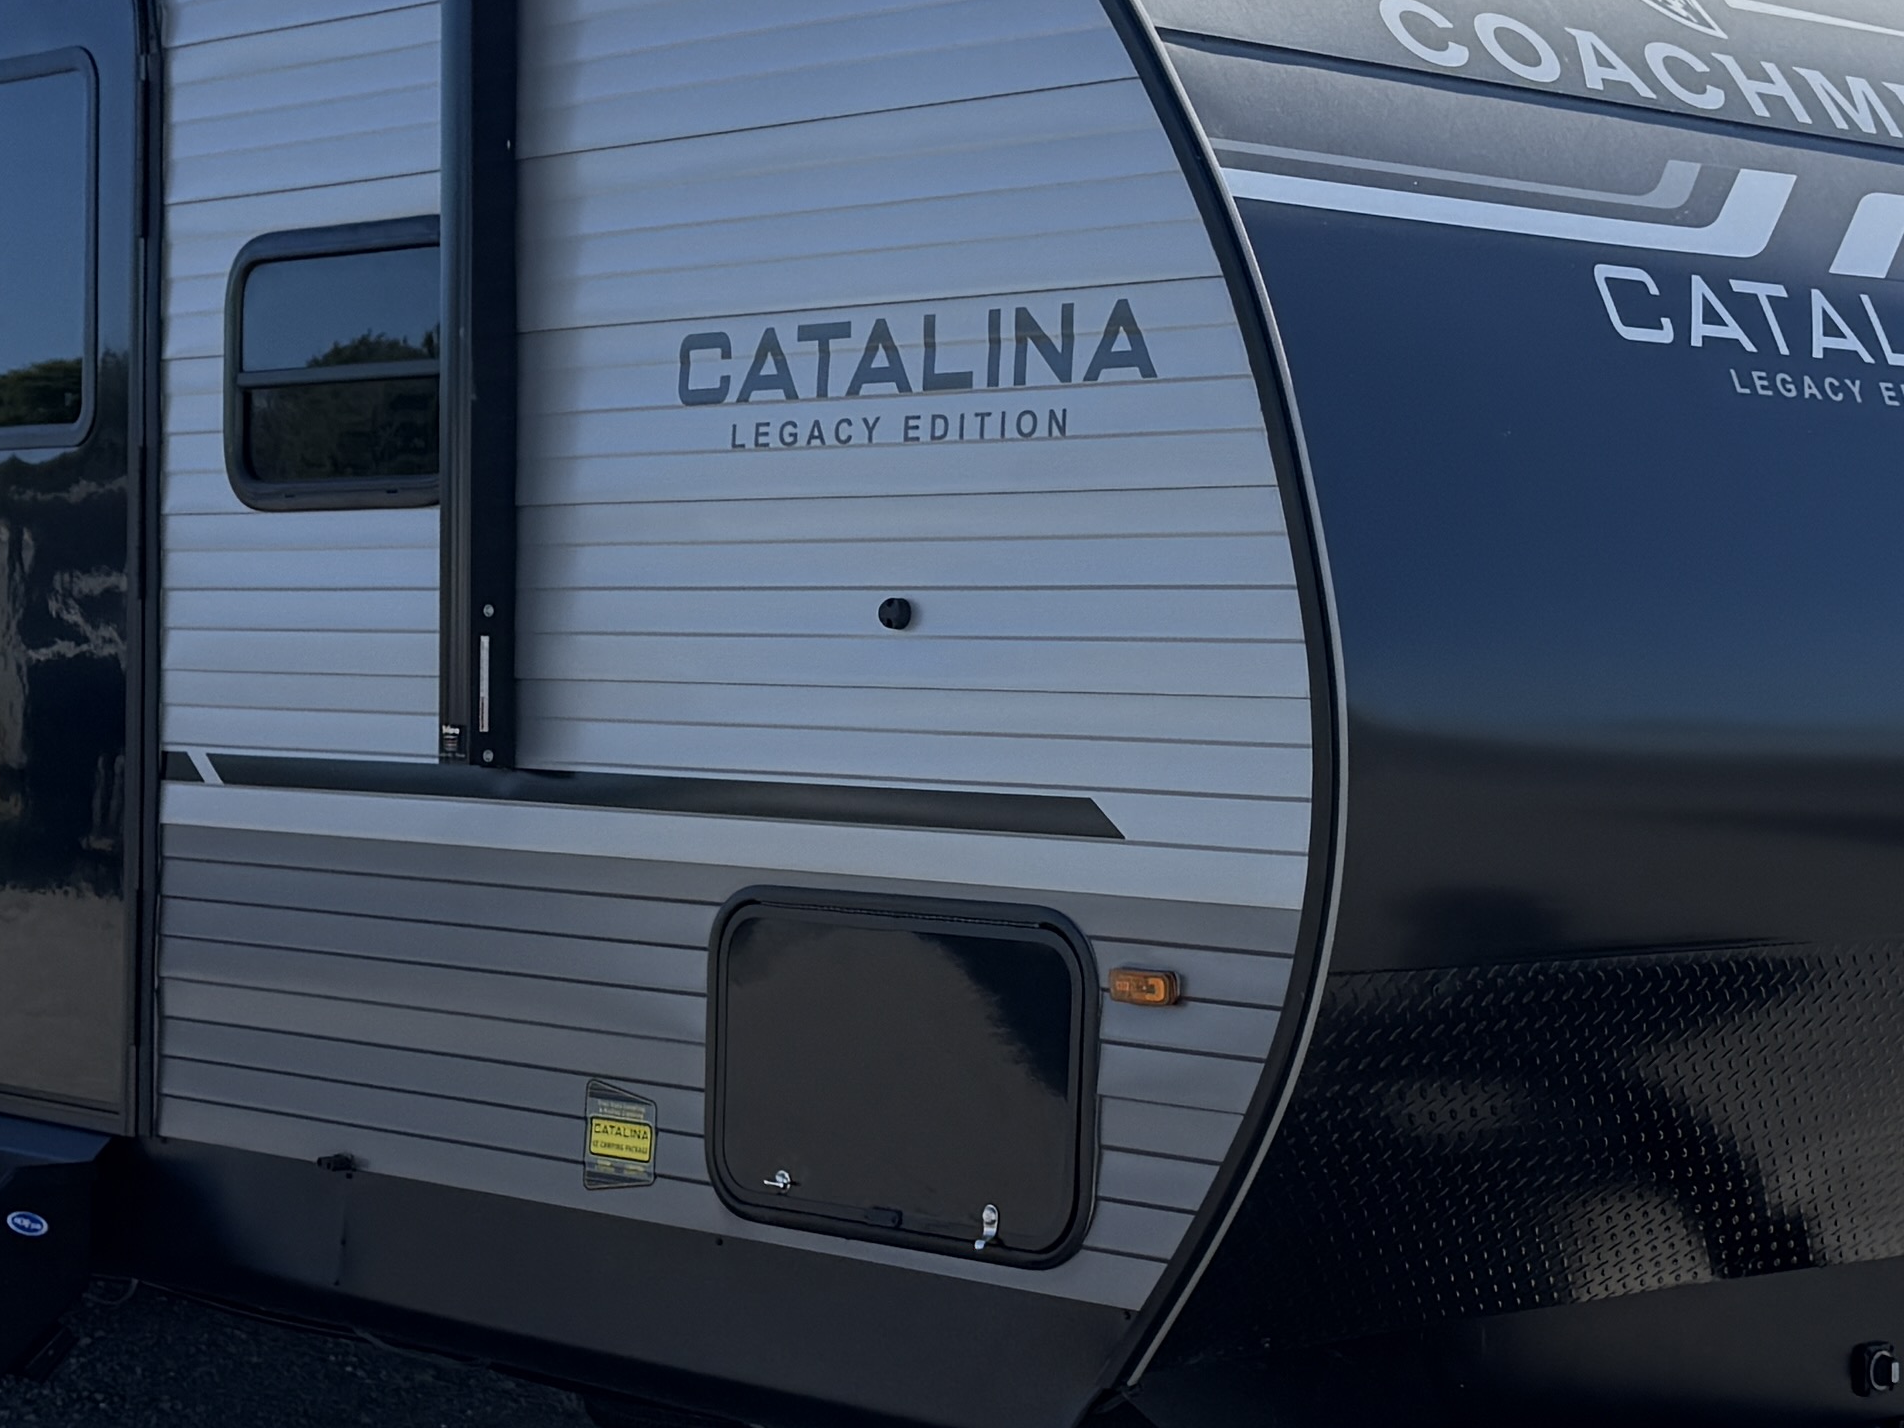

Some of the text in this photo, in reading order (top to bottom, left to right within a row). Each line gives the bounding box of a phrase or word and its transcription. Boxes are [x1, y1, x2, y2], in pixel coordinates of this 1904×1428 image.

[677, 298, 1158, 406] CATALINA
[1729, 368, 1864, 404] LEGACY
[730, 407, 1069, 450] LEGACY EDITION
[594, 1122, 650, 1140] CATALINA
